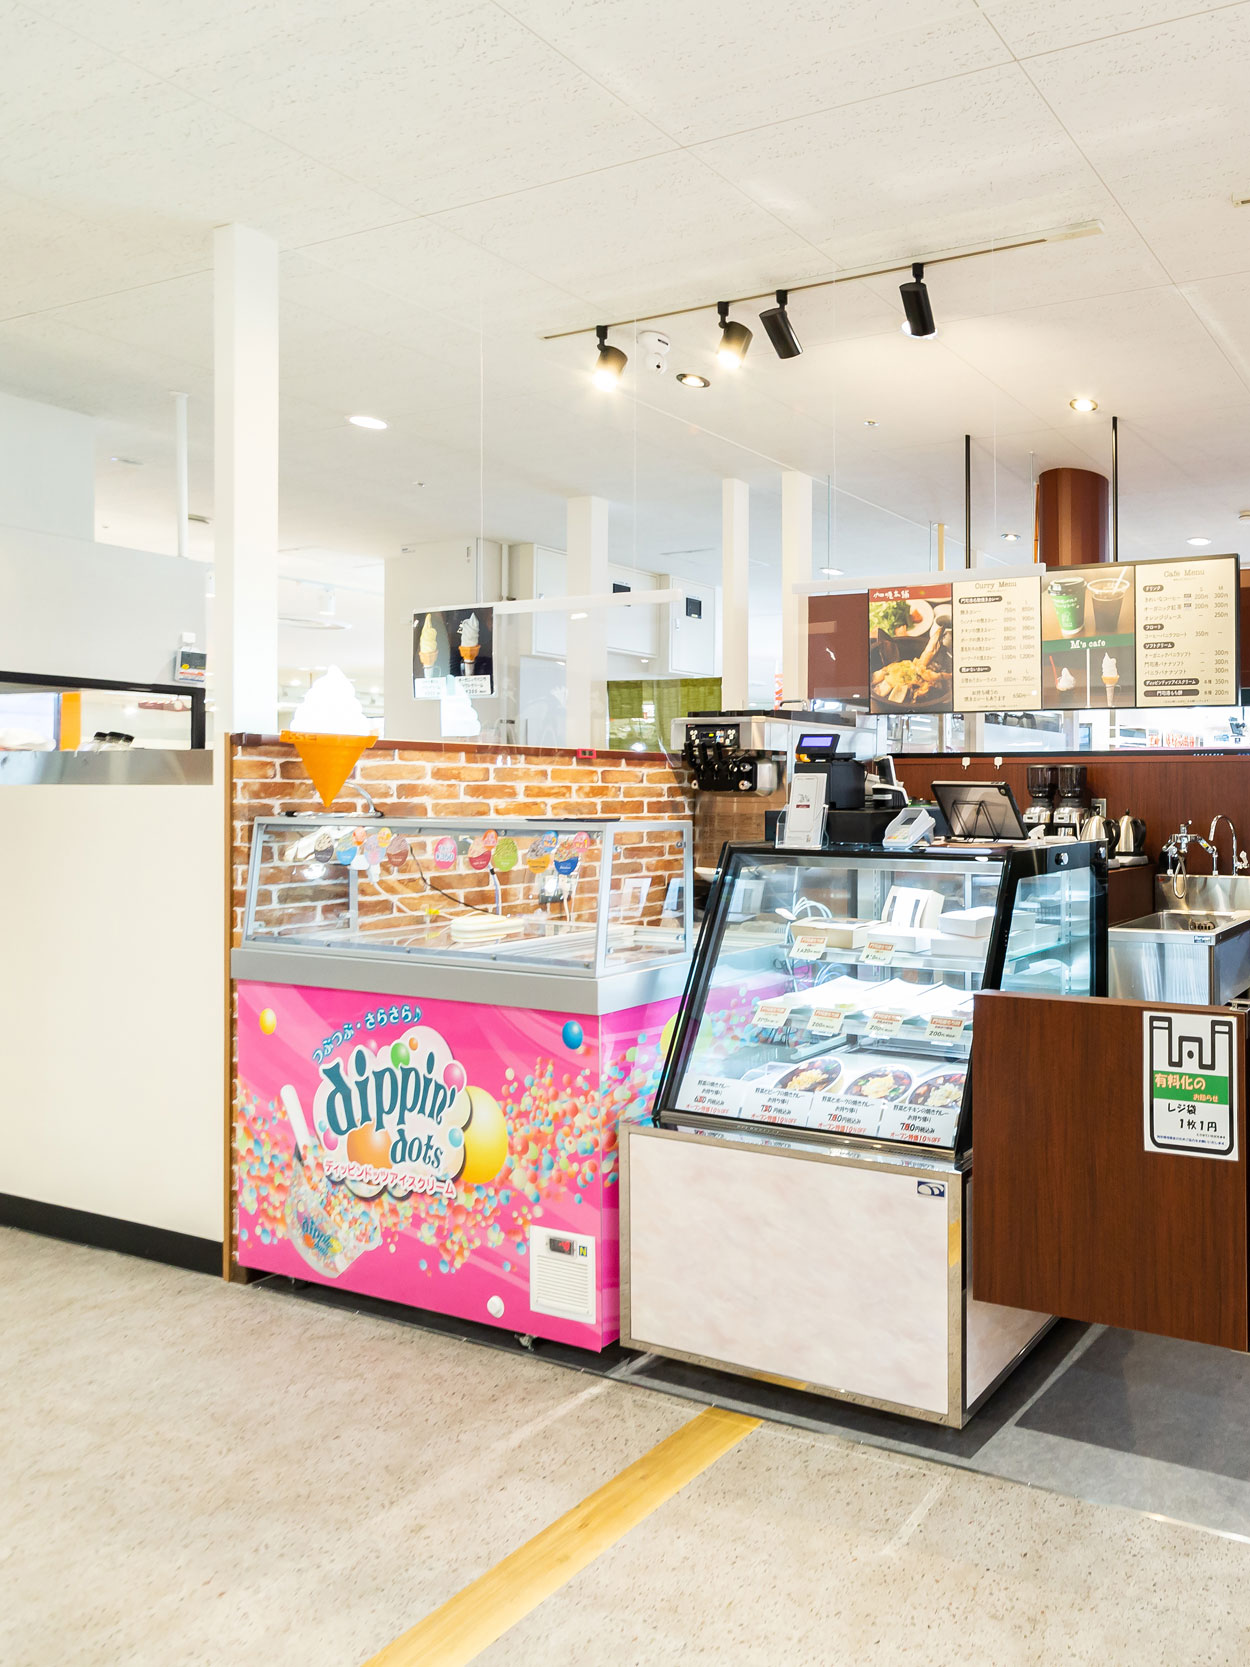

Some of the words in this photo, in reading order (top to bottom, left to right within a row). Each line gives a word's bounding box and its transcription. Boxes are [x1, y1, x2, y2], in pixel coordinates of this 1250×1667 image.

[1070, 640, 1087, 650] M's
[1088, 640, 1106, 648] cafe
[322, 1049, 456, 1136] dippin'
[1154, 1073, 1206, 1091] 有料化の
[1167, 1102, 1197, 1115] レジ袋
[390, 1128, 444, 1169] dots
[324, 1160, 456, 1197] ディッピンドッツアイスクリーム
